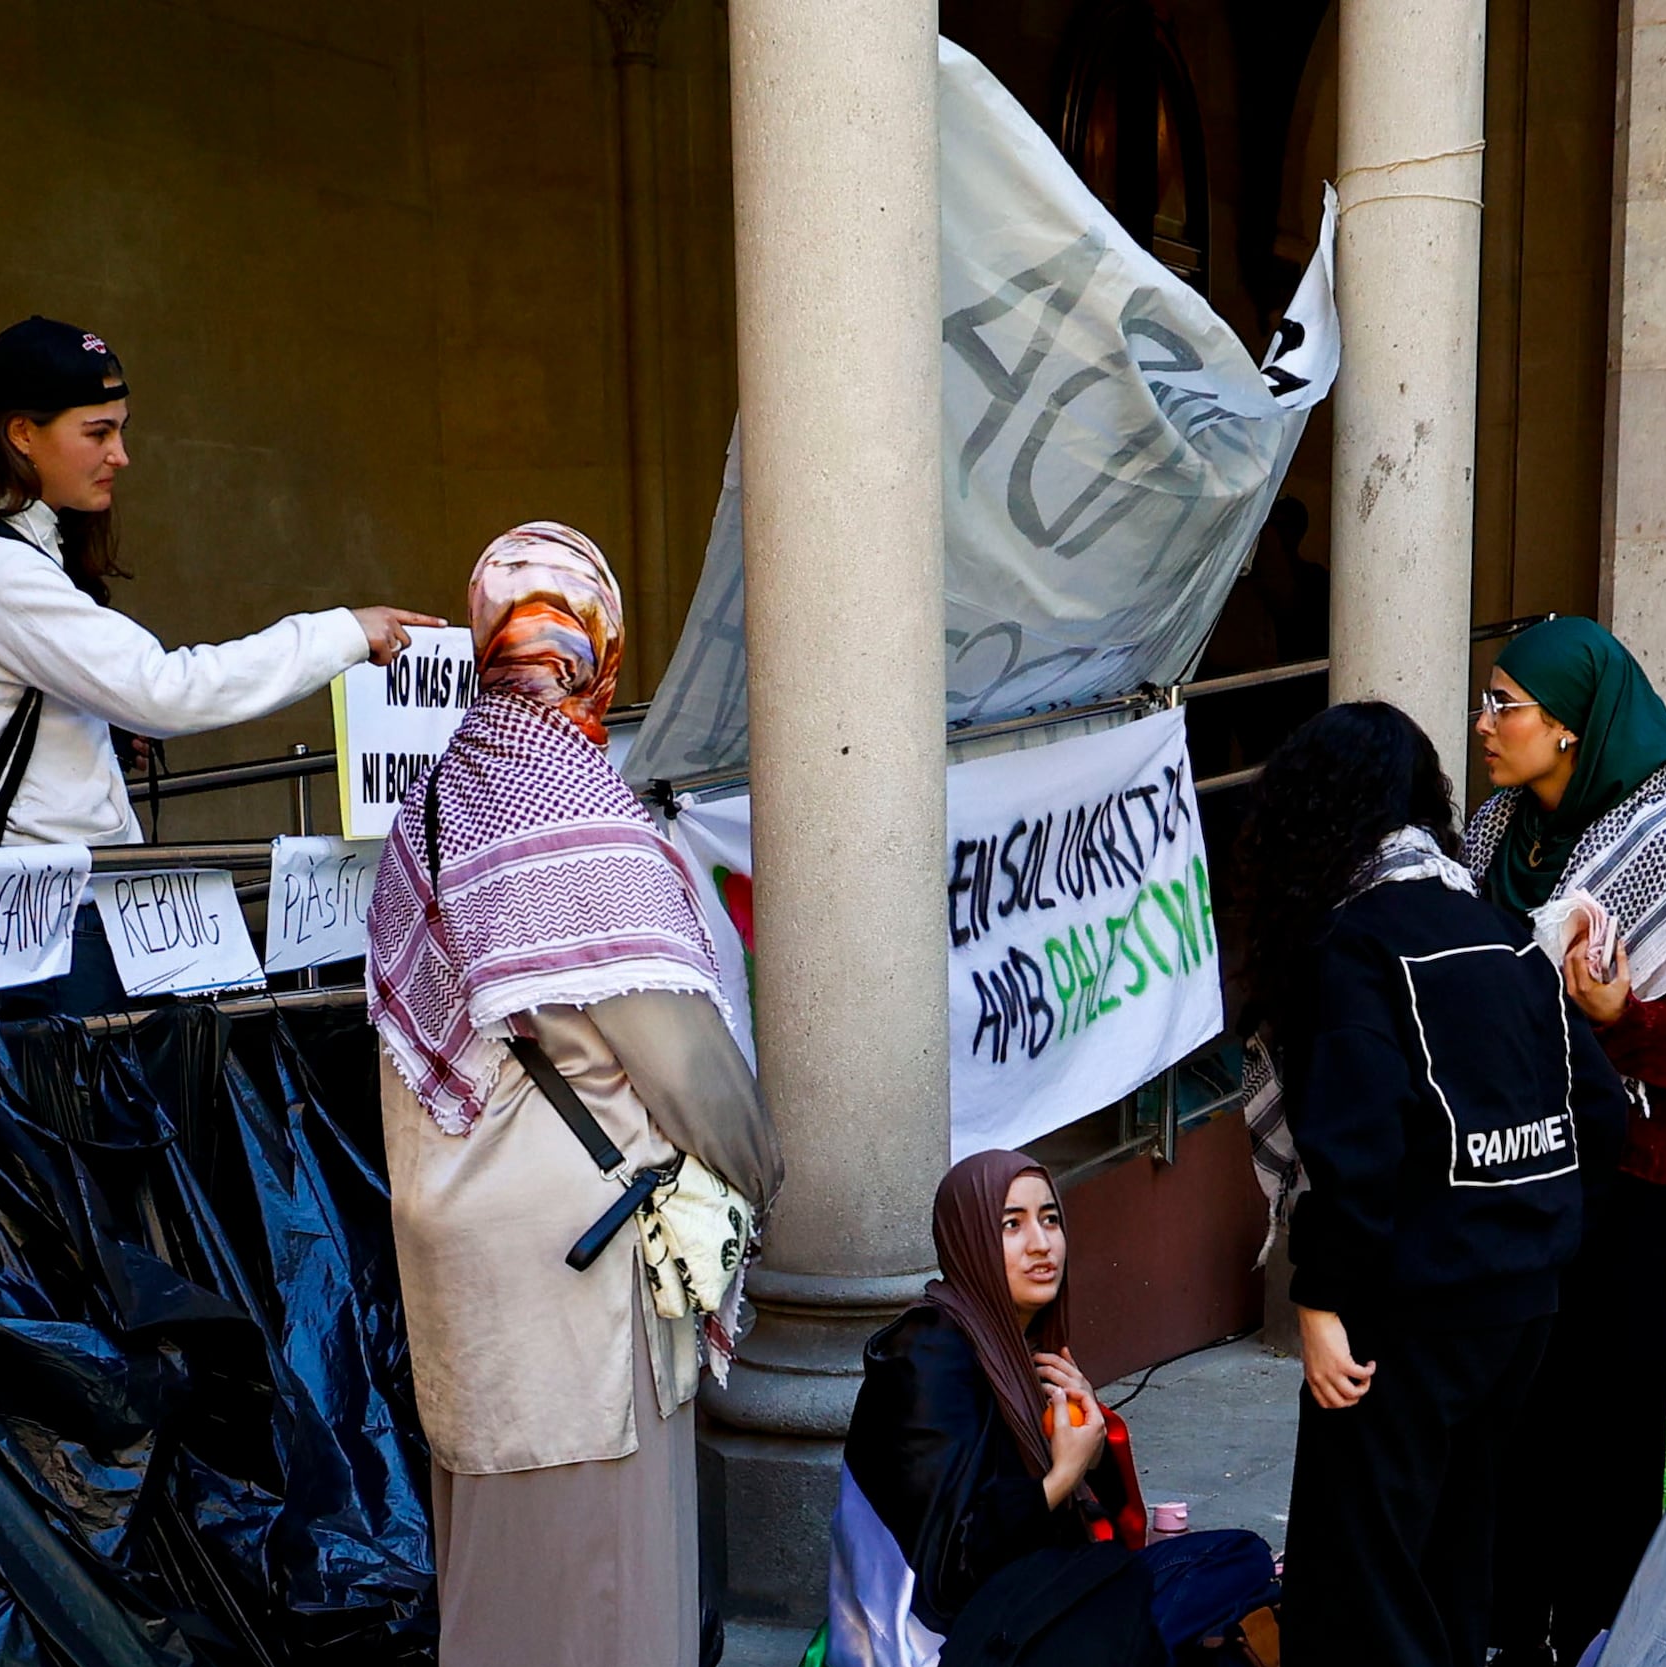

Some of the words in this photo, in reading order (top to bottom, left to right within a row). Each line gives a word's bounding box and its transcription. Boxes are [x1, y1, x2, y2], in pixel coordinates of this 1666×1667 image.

[386, 656, 410, 708] NO
[416, 644, 453, 709] MÁS
[361, 752, 381, 804] NI
[114, 871, 221, 959] REBUIG
